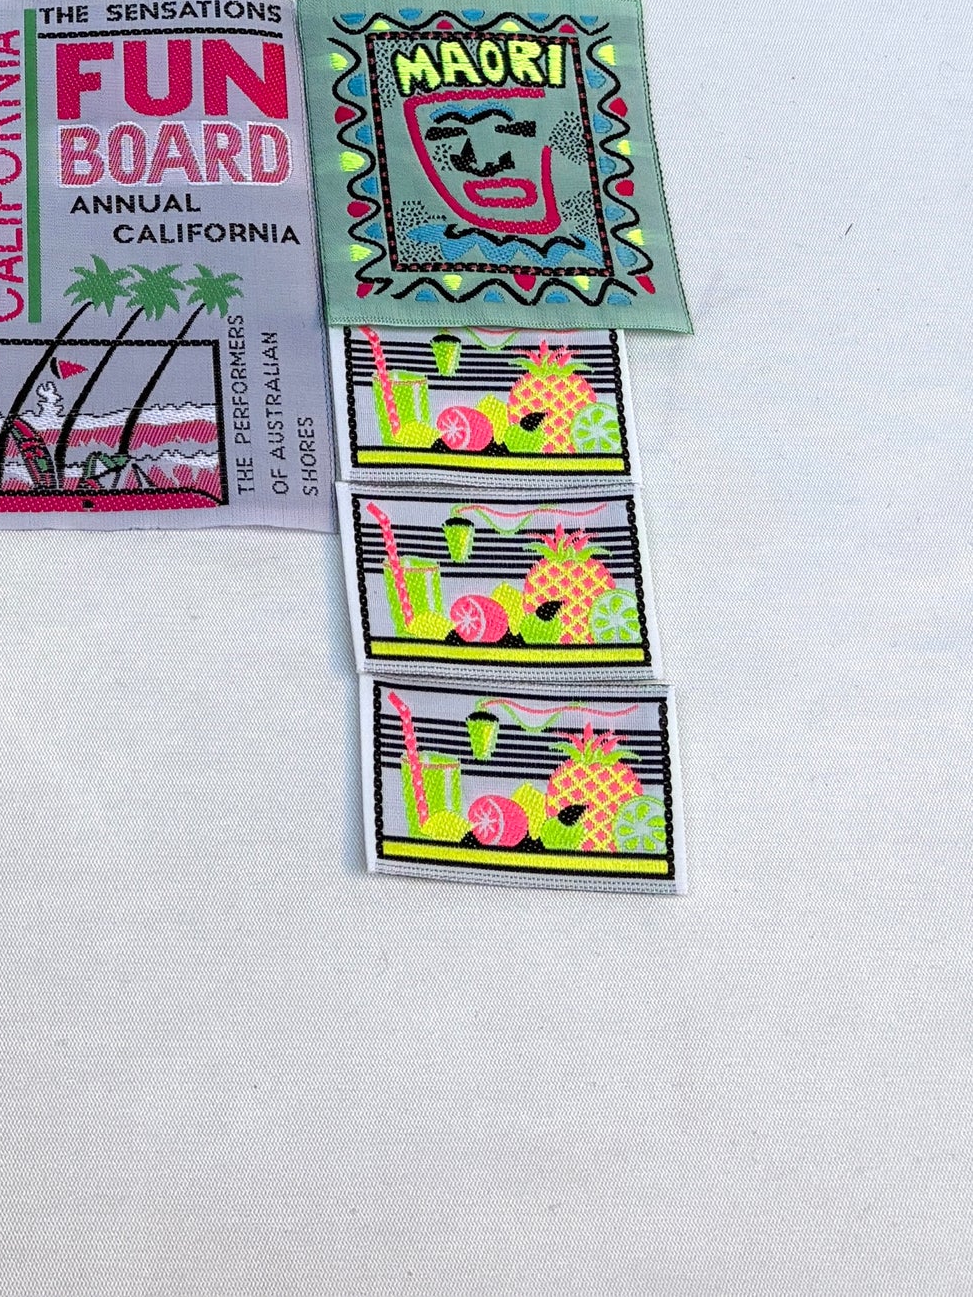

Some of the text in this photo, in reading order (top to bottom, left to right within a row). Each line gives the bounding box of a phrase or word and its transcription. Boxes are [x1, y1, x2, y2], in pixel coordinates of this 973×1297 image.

[39, 0, 282, 24] THE SENSATIONS
[56, 39, 289, 120] FUN
[392, 40, 566, 97] MAORI
[58, 121, 292, 188] BOARD
[70, 193, 201, 214] ANNUAL
[113, 223, 301, 245] CALIFORNIA
[228, 315, 255, 495] THE PERFORMERS
[261, 332, 290, 495] OF AUSTRALIAN
[297, 417, 319, 496] SHORES
